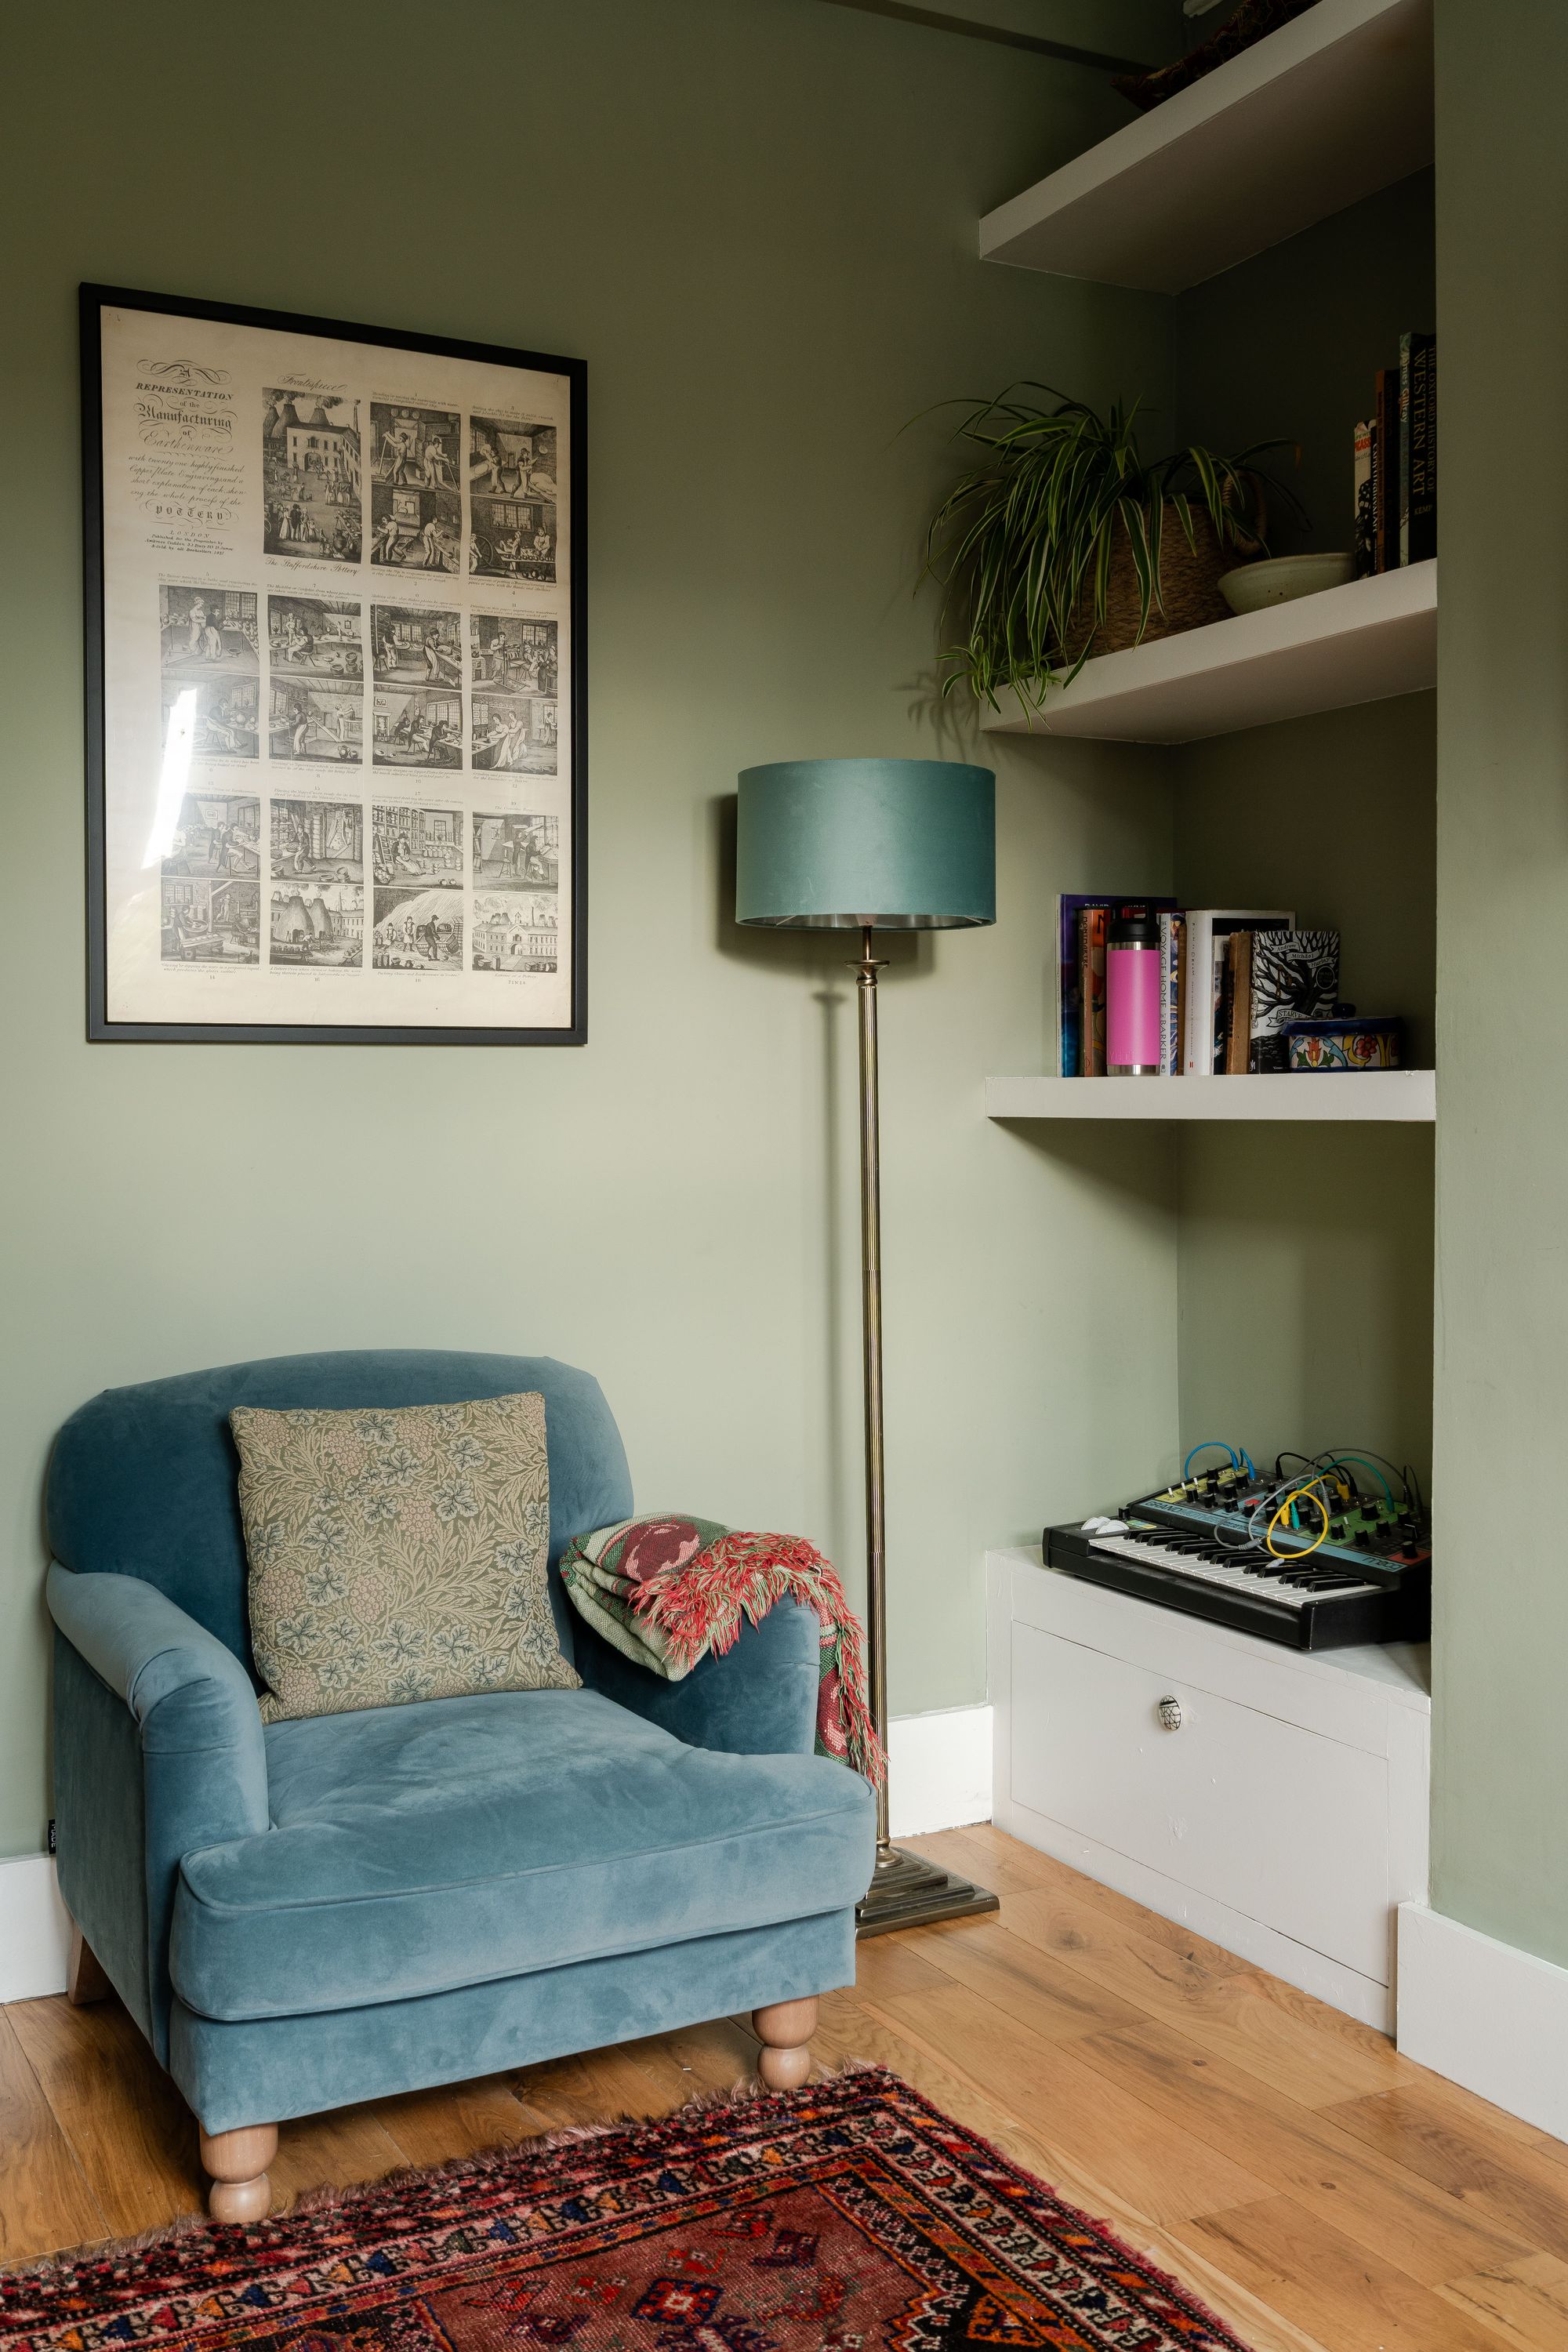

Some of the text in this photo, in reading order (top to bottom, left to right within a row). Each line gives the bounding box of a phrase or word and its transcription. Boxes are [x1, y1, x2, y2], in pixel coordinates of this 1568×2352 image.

[1400, 350, 1410, 386] James
[135, 381, 235, 401] REPRESENTATION
[1427, 372, 1436, 417] OXFORD
[1400, 388, 1410, 423] Gillray
[133, 401, 232, 431] Manufacturing
[1413, 348, 1426, 495] WESTERN ART
[128, 452, 145, 462] with
[1427, 423, 1436, 472] HISTORY
[130, 474, 150, 485] short
[1427, 477, 1436, 492] OF
[146, 488, 158, 496] the
[163, 489, 185, 499] whole
[230, 497, 243, 506] the
[169, 529, 210, 539] LONDON
[265, 557, 278, 565] The
[281, 558, 326, 573] Staffordshire
[330, 563, 358, 576] Pottery
[1311, 956, 1331, 967] Hurley
[1361, 1557, 1400, 1571] moog
